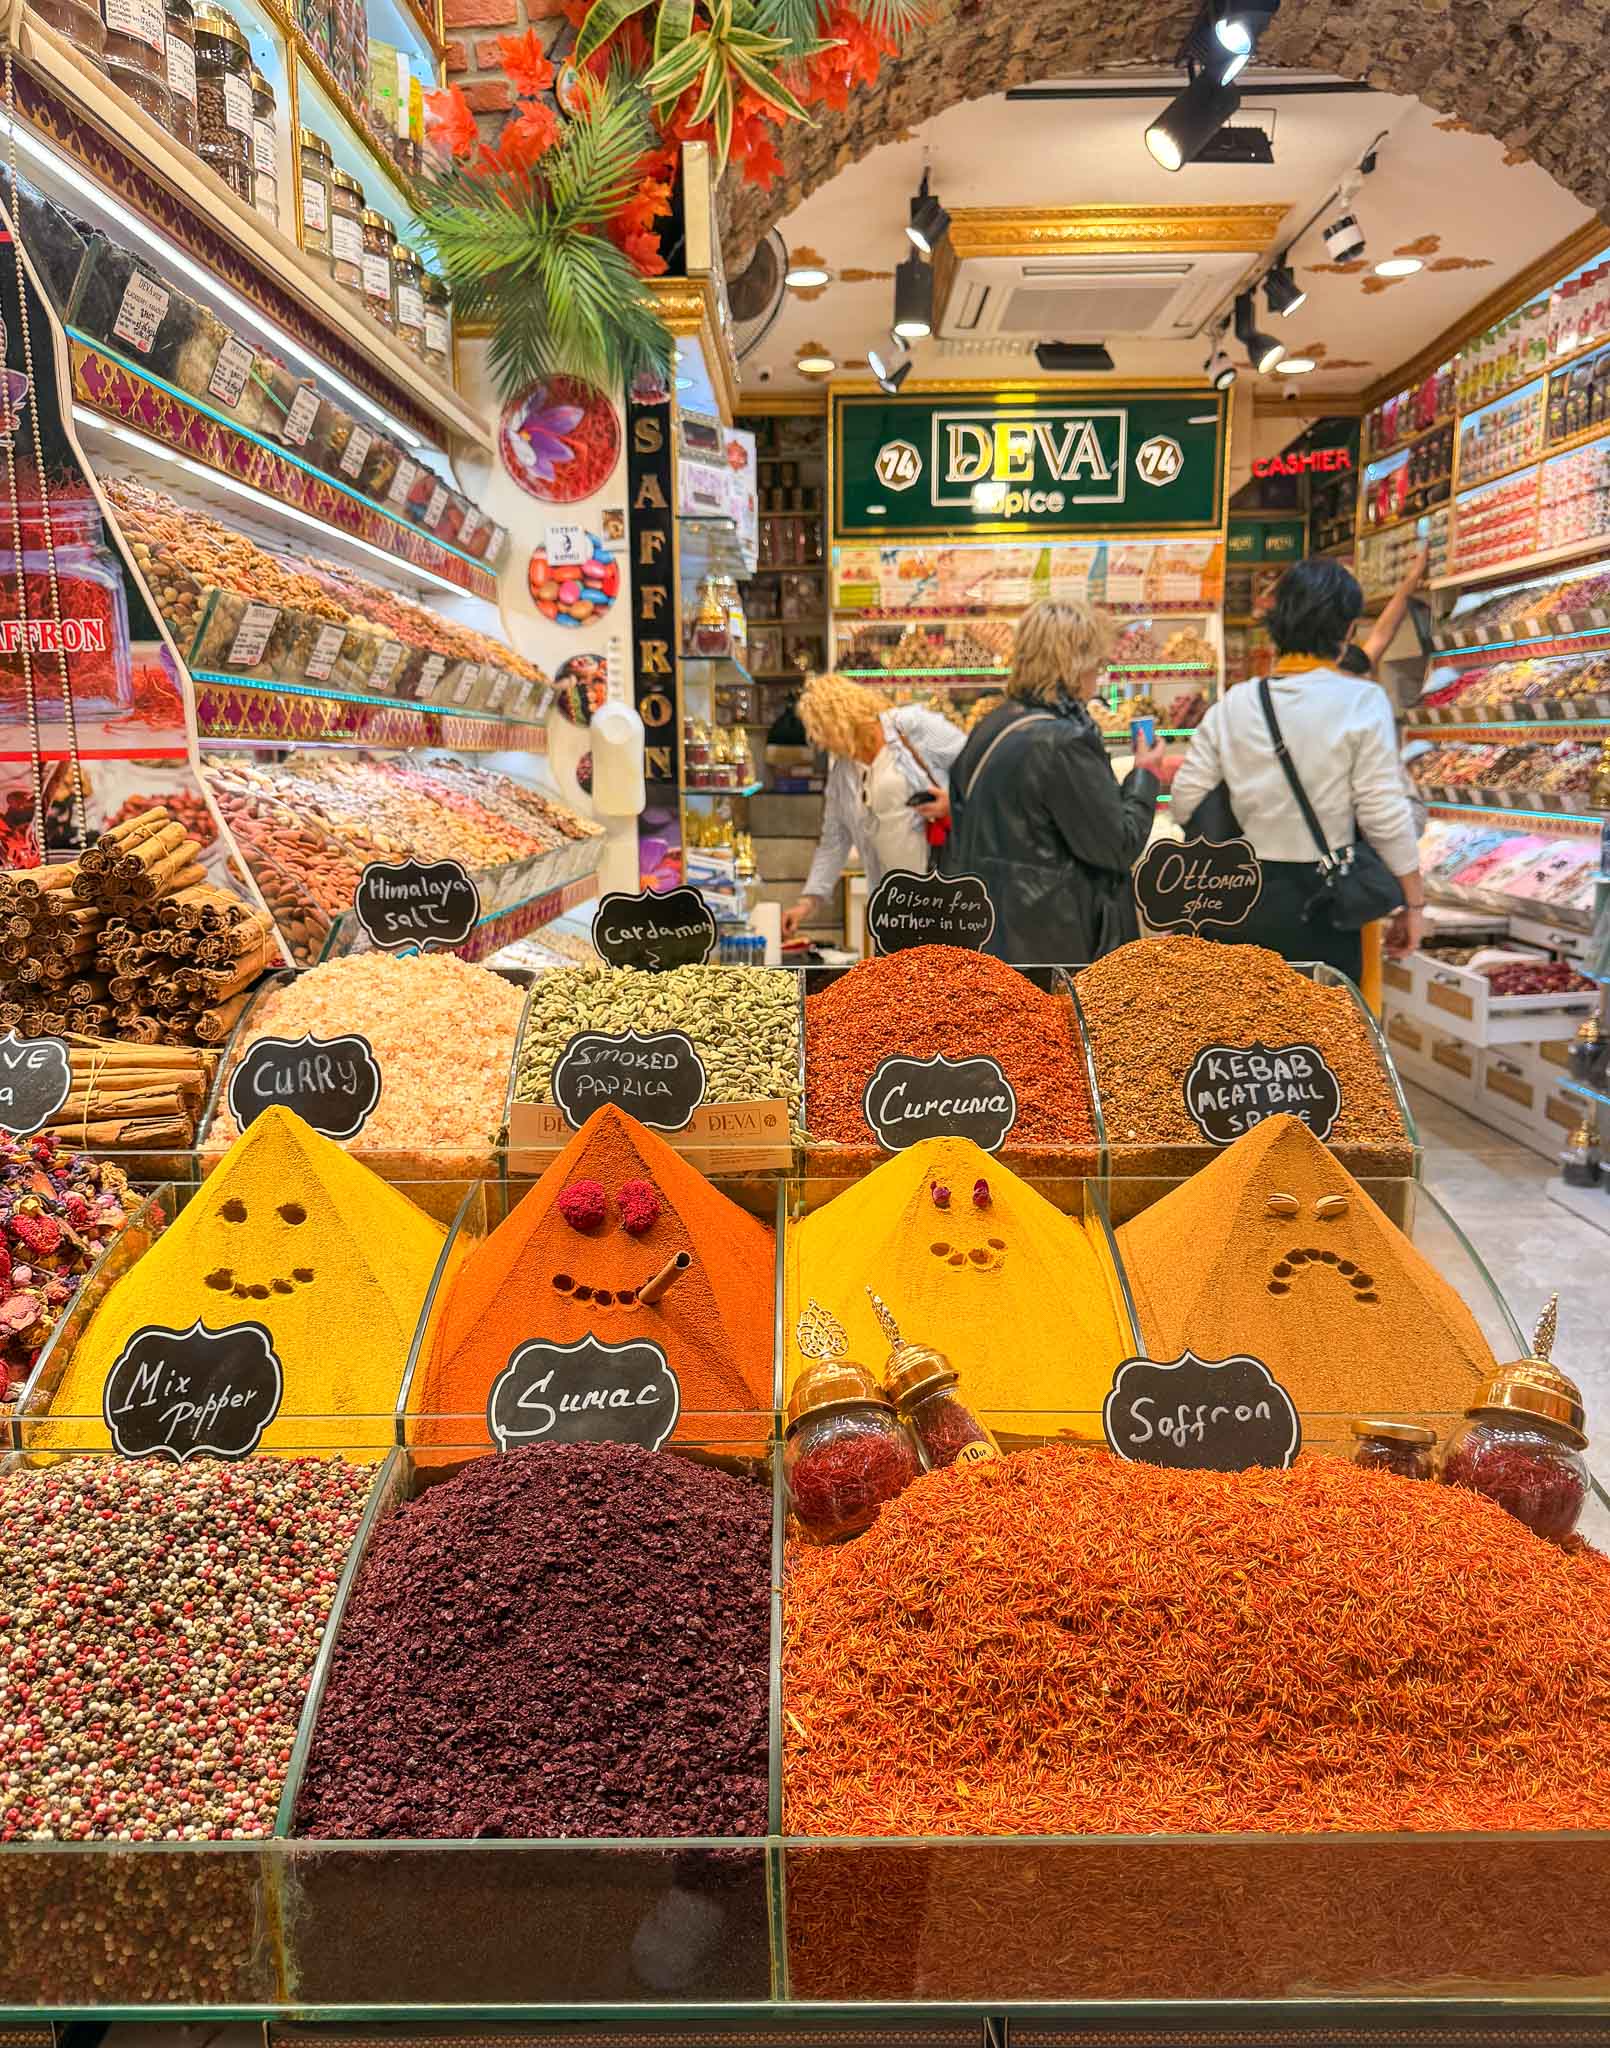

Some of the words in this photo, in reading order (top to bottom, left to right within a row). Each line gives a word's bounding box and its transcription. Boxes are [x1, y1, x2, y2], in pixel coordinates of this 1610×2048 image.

[945, 420, 1112, 482] DEVA
[1252, 448, 1352, 478] CASHIER
[634, 417, 673, 779] SAFFRON
[0, 619, 106, 653] FFRON
[1156, 854, 1261, 893] Ottoman
[369, 876, 469, 906] Himalaya
[887, 886, 943, 908] Poison
[605, 919, 713, 945] Cardamon
[940, 916, 953, 930] in
[569, 1046, 679, 1070] SMOKED
[1207, 1054, 1313, 1082] KEBAB
[575, 1074, 673, 1098] PAPRICA
[880, 1081, 1009, 1125] Curcuma
[708, 1113, 756, 1131] DEVA
[112, 1360, 191, 1414] Mix
[158, 1384, 258, 1444] Pepper
[497, 1369, 660, 1437] Sumac
